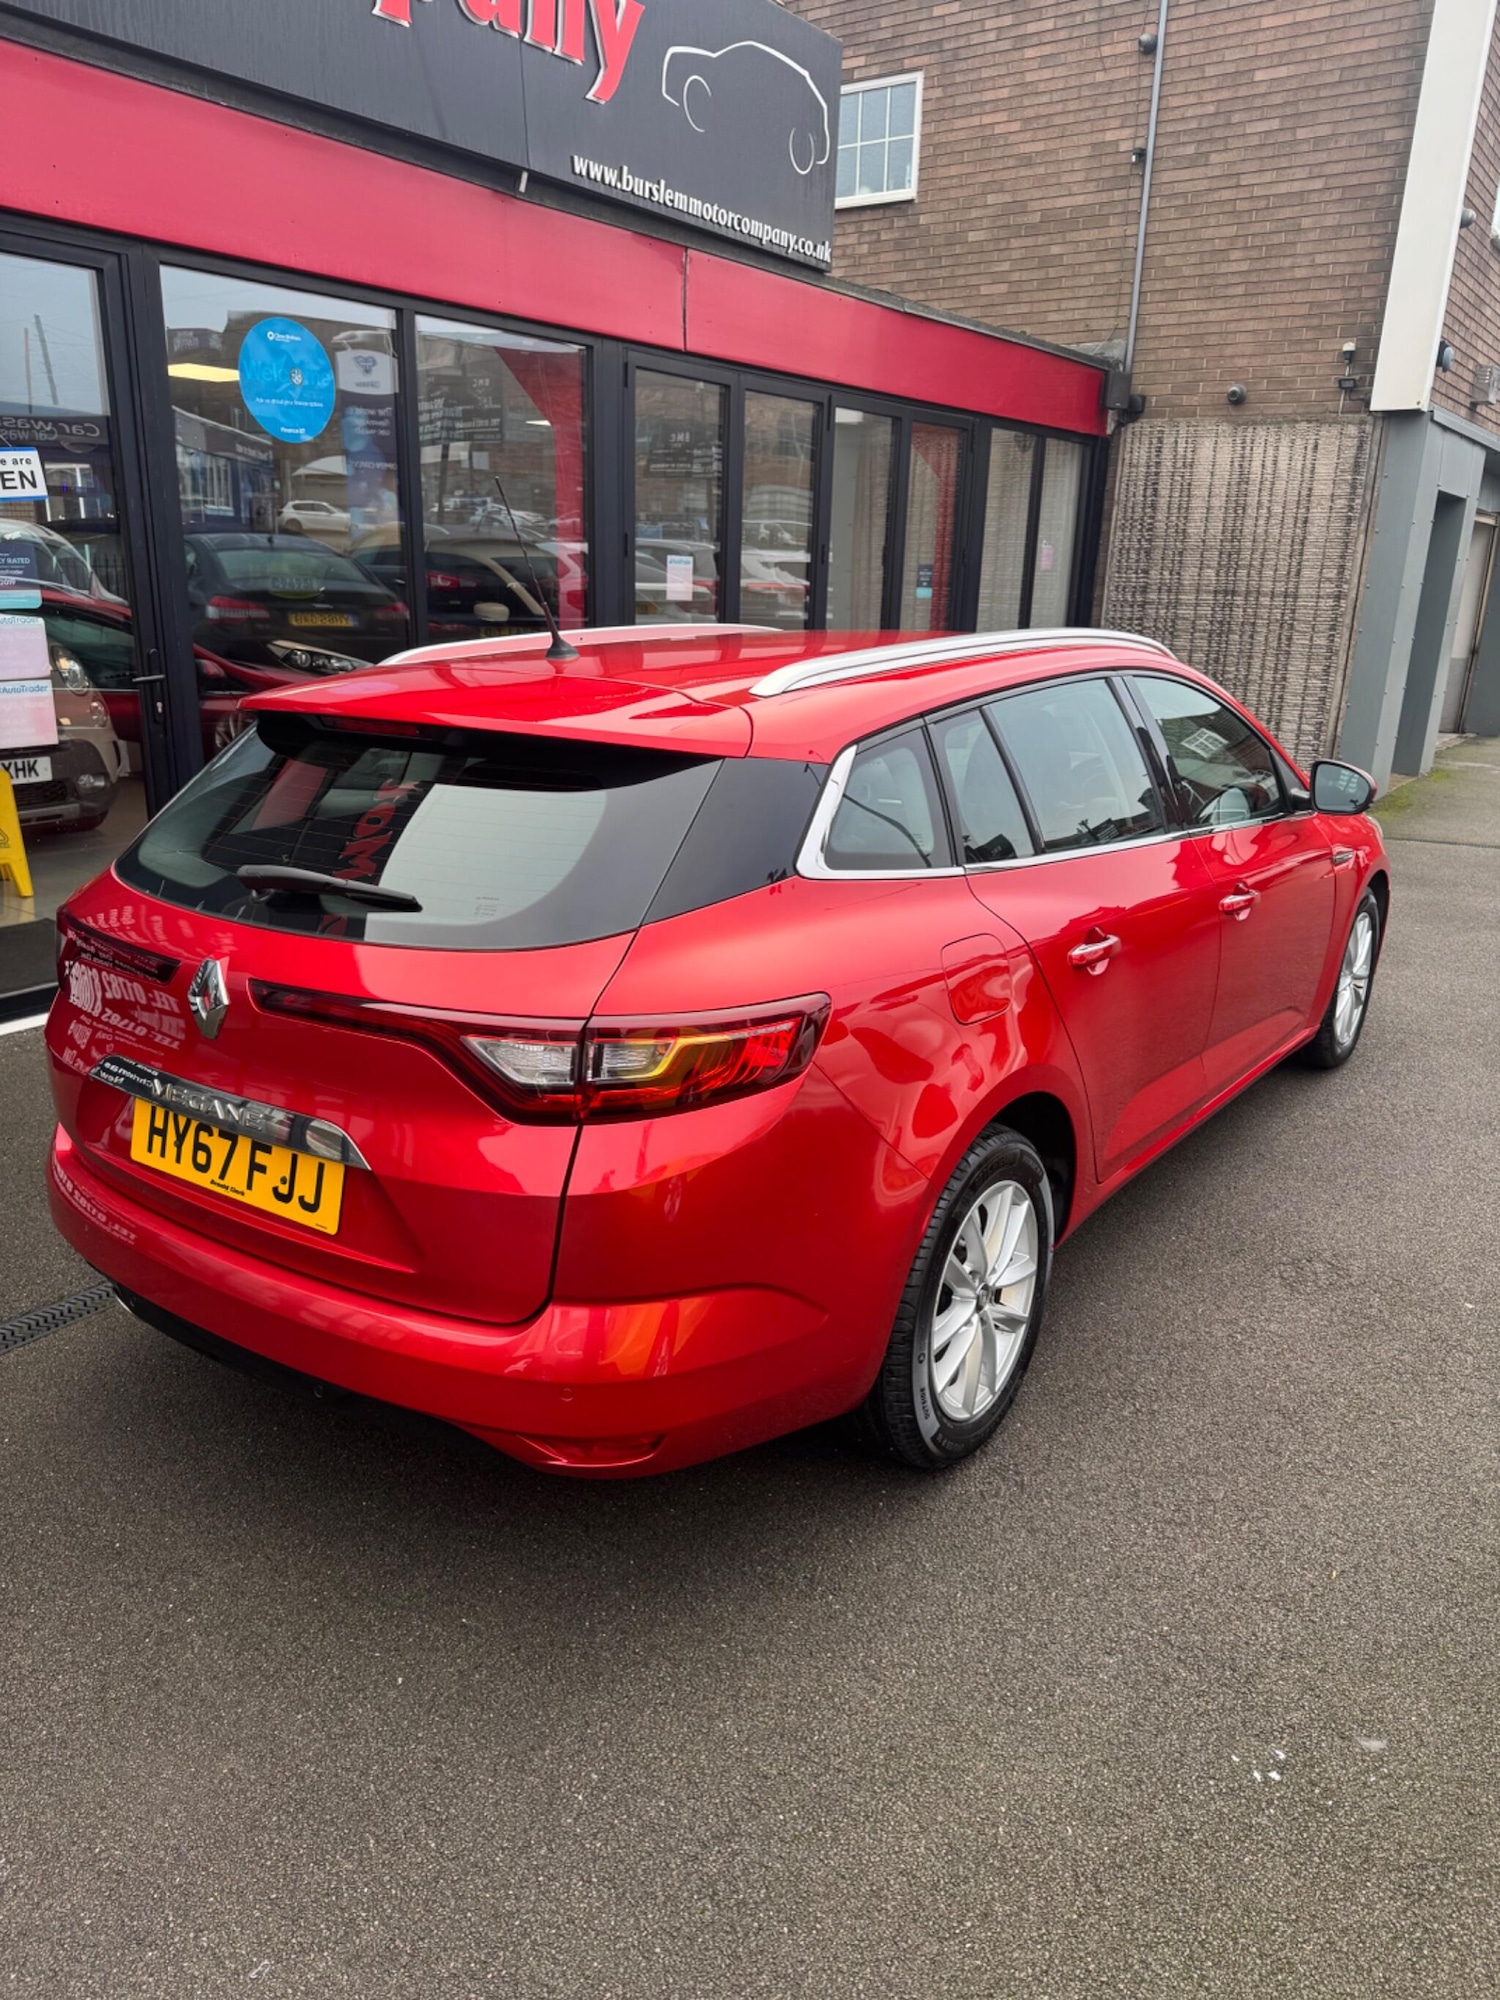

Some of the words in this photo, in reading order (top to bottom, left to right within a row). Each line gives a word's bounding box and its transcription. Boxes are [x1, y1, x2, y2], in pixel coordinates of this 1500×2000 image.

[572, 154, 832, 263] www.burslemmotorcompany.co.uk
[12, 457, 32, 465] are
[2, 684, 48, 694] AutoTrader
[152, 1078, 264, 1132] MEGANE
[147, 1105, 238, 1182] HY67
[246, 1138, 325, 1214] FJJ
